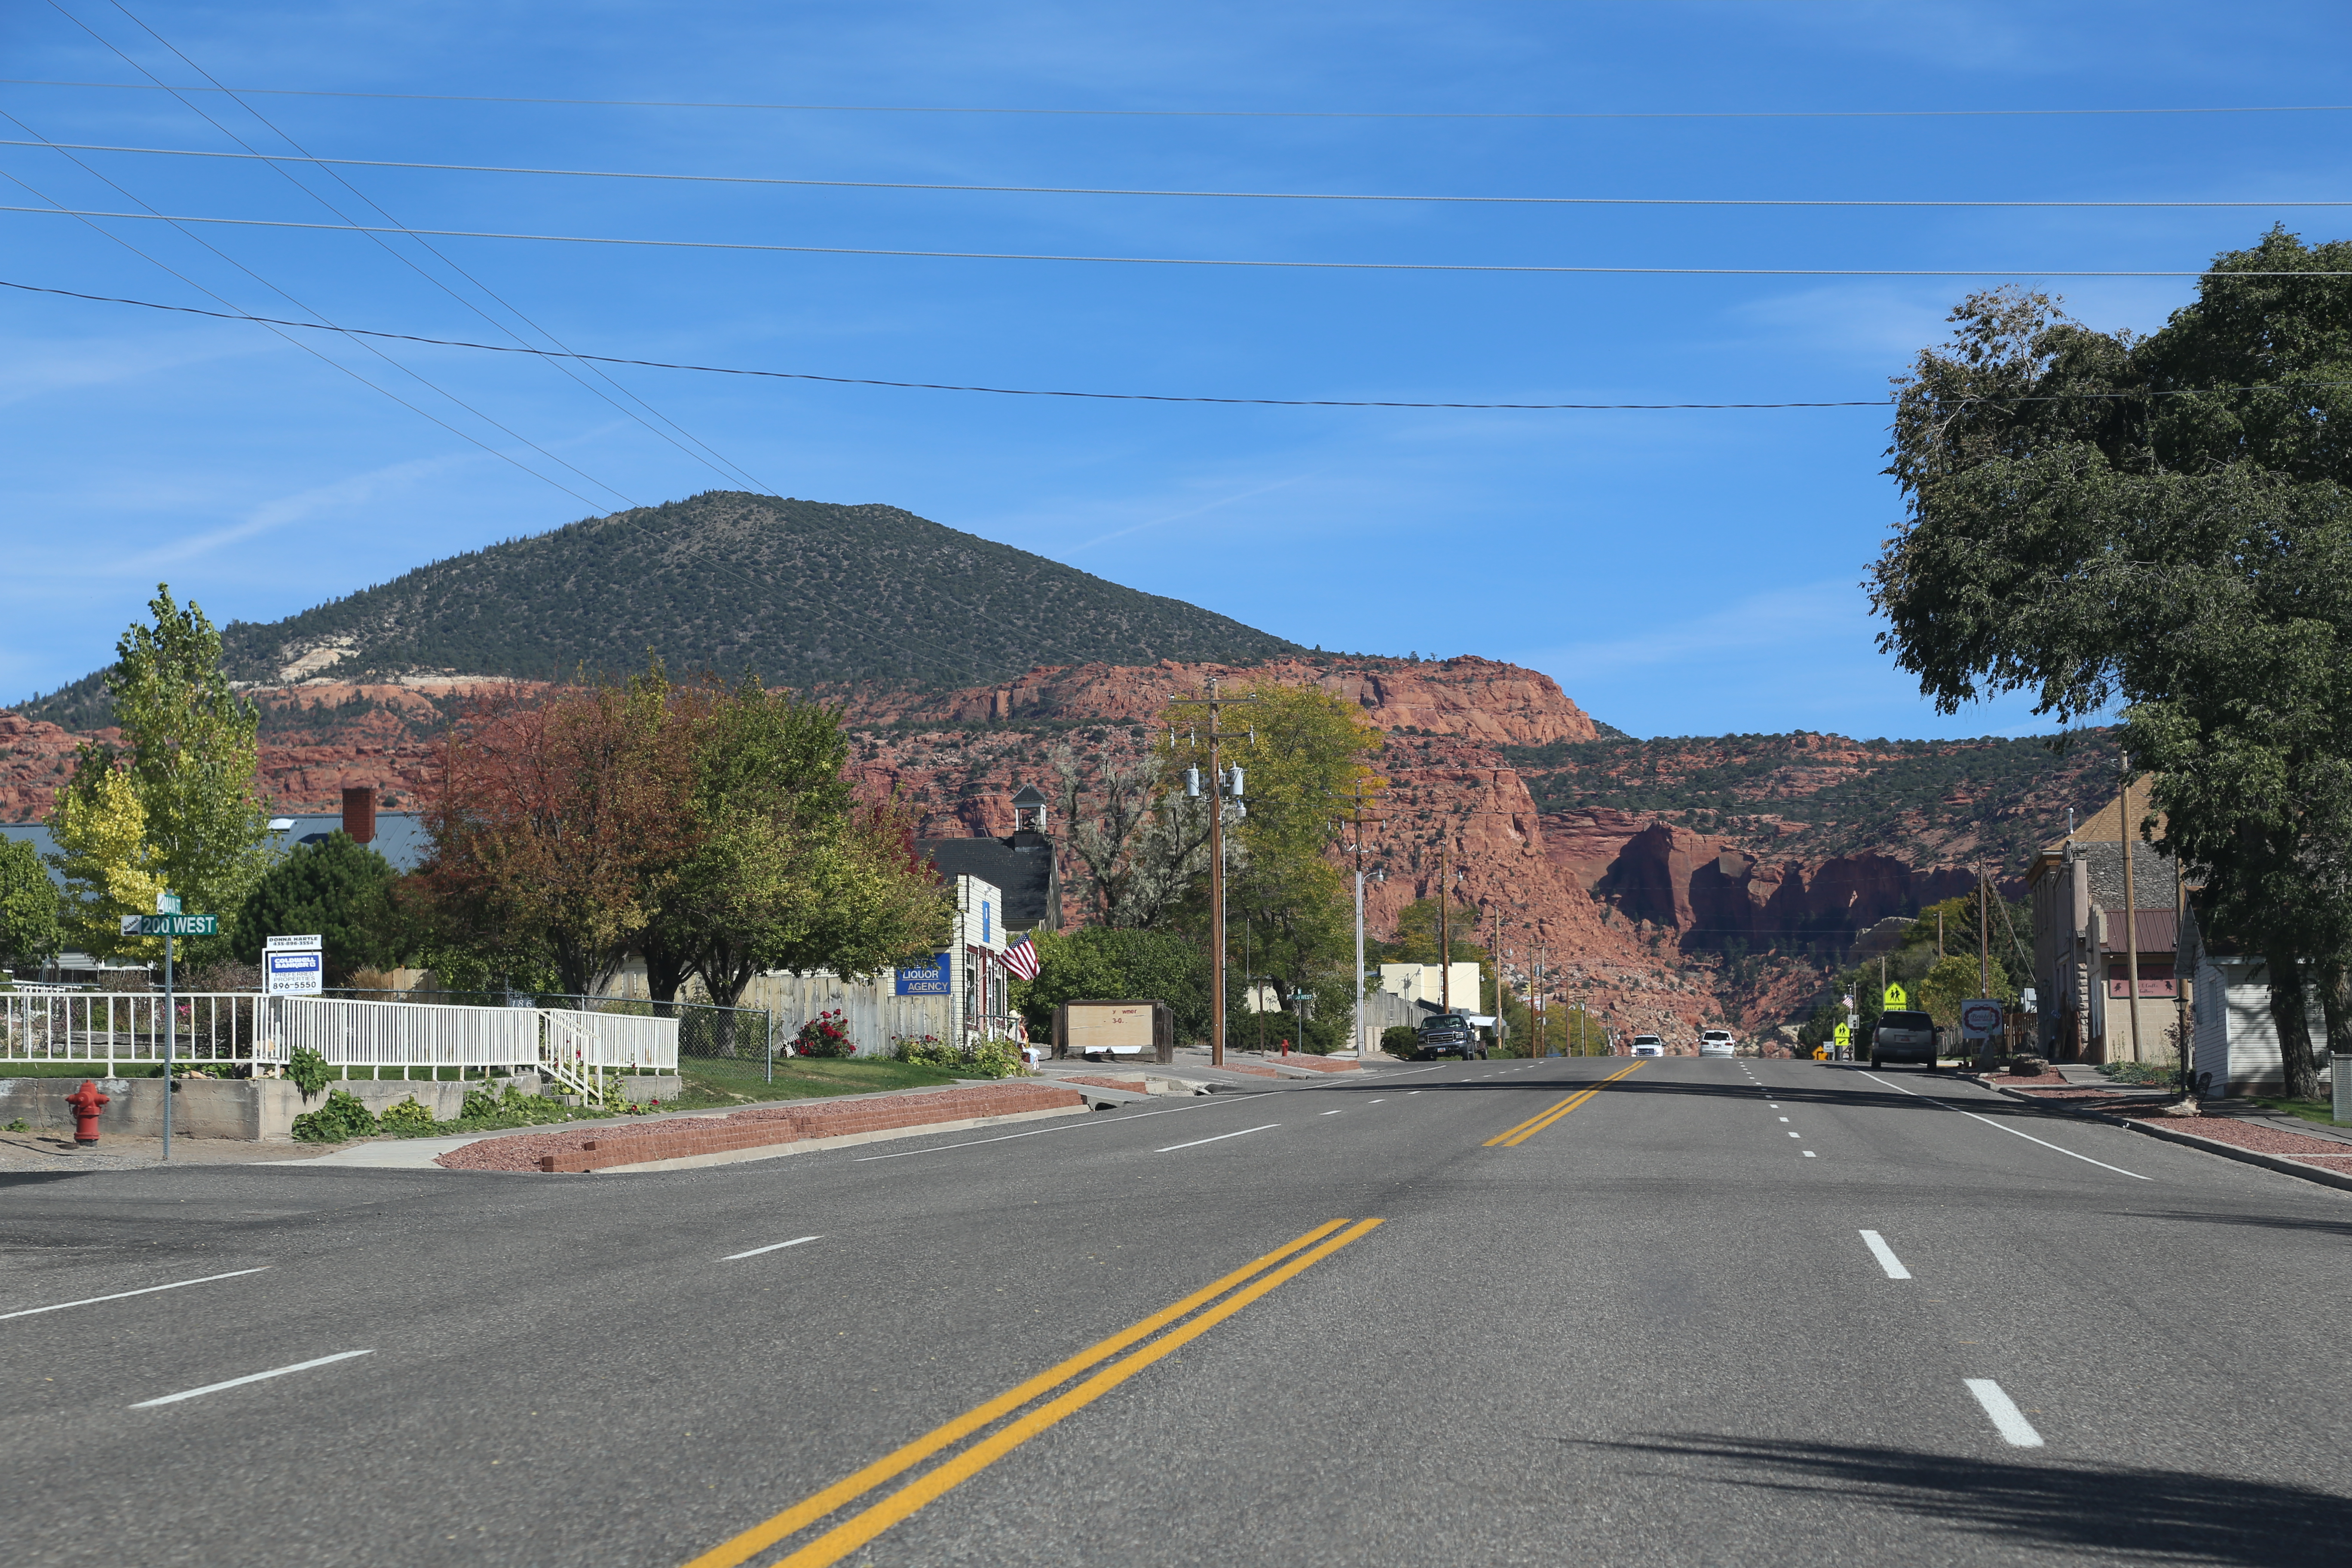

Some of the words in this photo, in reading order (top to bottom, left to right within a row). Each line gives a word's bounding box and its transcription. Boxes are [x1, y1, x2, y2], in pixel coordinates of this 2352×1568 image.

[164, 897, 176, 914] MAIN
[123, 916, 139, 931] Bicknell
[143, 917, 170, 933] 200
[173, 917, 214, 933] WEST
[903, 970, 939, 979] LIQUOR
[908, 982, 948, 991] AGENCY
[512, 999, 532, 1008] 186
